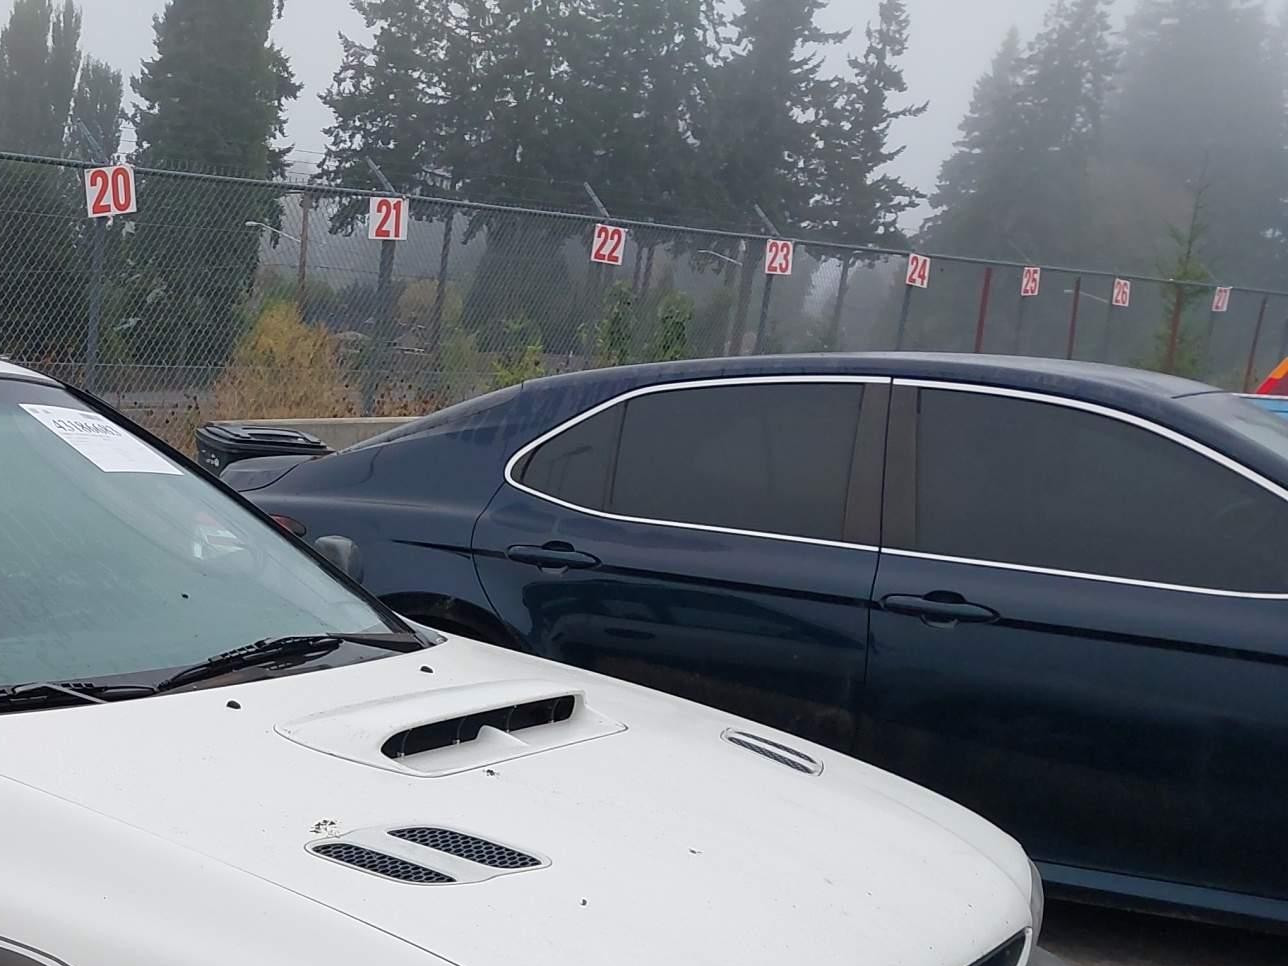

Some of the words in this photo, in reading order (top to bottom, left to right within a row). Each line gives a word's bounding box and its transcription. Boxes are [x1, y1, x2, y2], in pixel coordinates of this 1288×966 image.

[89, 167, 131, 215] 20
[376, 198, 403, 239] 21
[593, 226, 623, 264] 22
[766, 240, 793, 273] 23
[907, 254, 928, 284] 24
[1021, 267, 1040, 296] 25
[1114, 279, 1130, 305] 26
